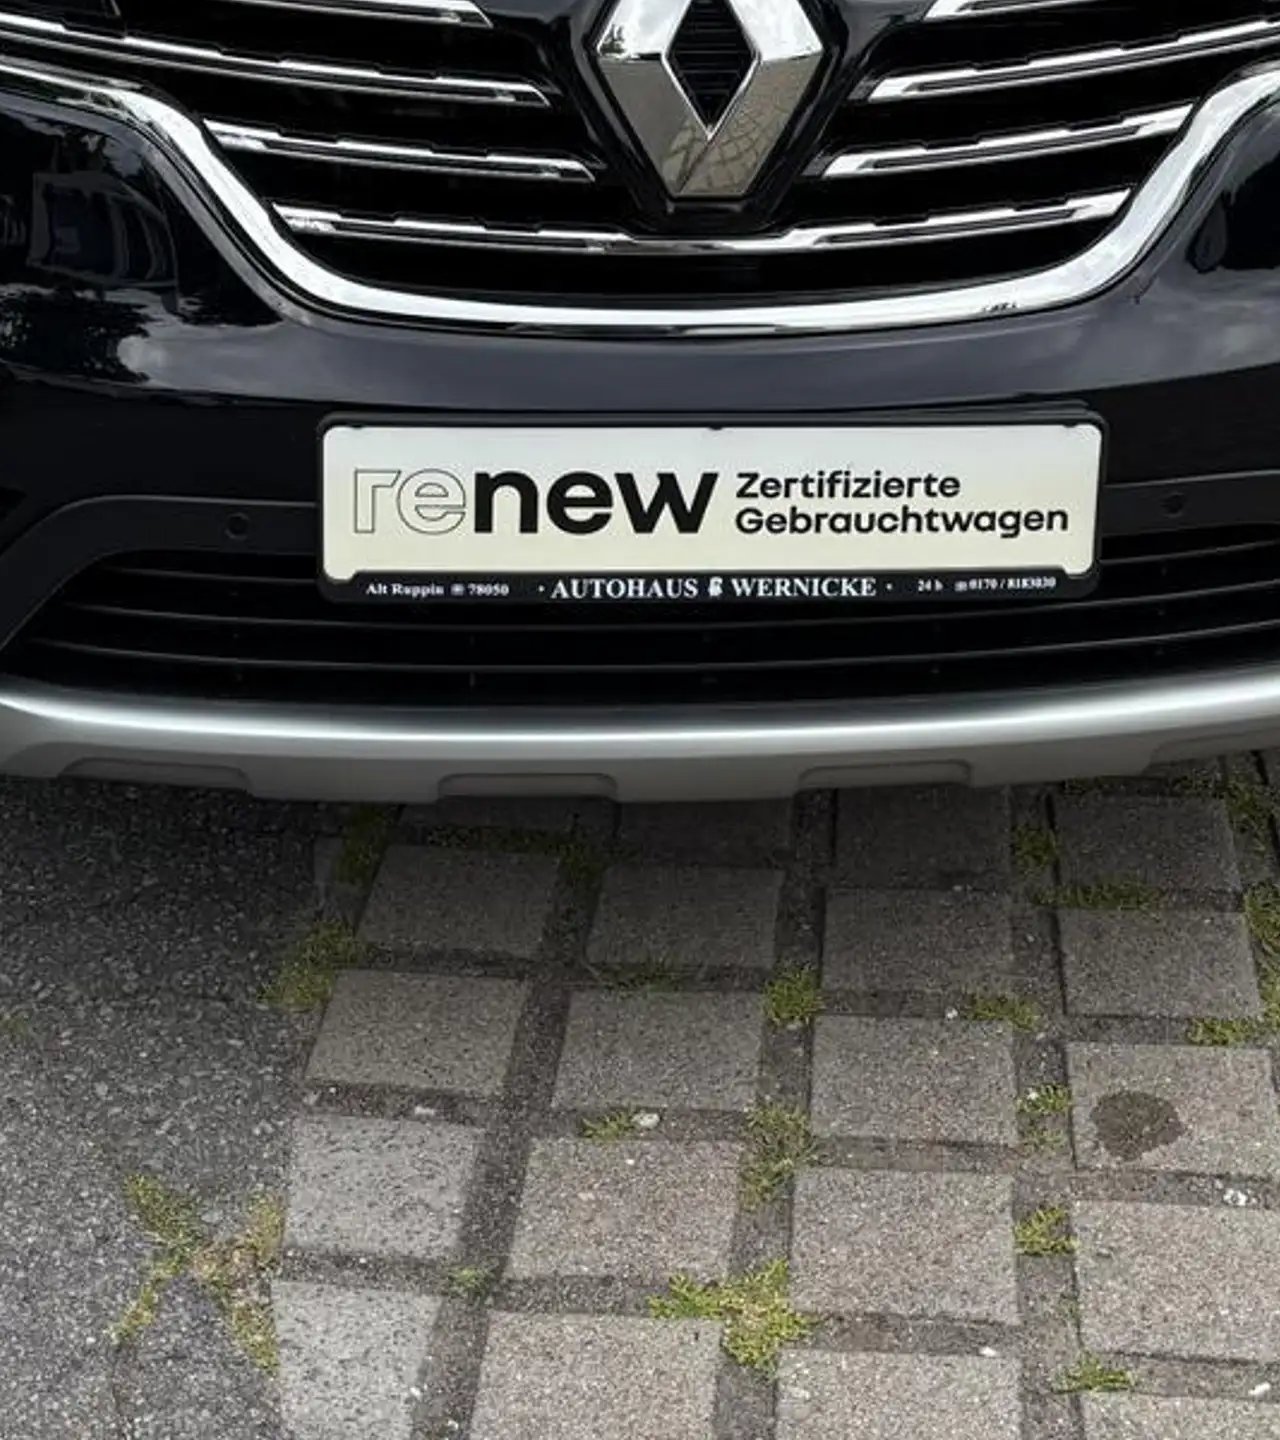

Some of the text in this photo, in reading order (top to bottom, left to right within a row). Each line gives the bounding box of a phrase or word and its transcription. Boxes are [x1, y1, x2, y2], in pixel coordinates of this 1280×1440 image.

[736, 469, 961, 500] Zertifizierte
[352, 468, 718, 535] renew
[735, 505, 1069, 539] Gebrauchtwagen
[366, 582, 387, 595] Alt
[392, 582, 445, 598] Ruppin
[550, 578, 698, 600] AUTOHAUS
[731, 576, 877, 598] WERNICKE
